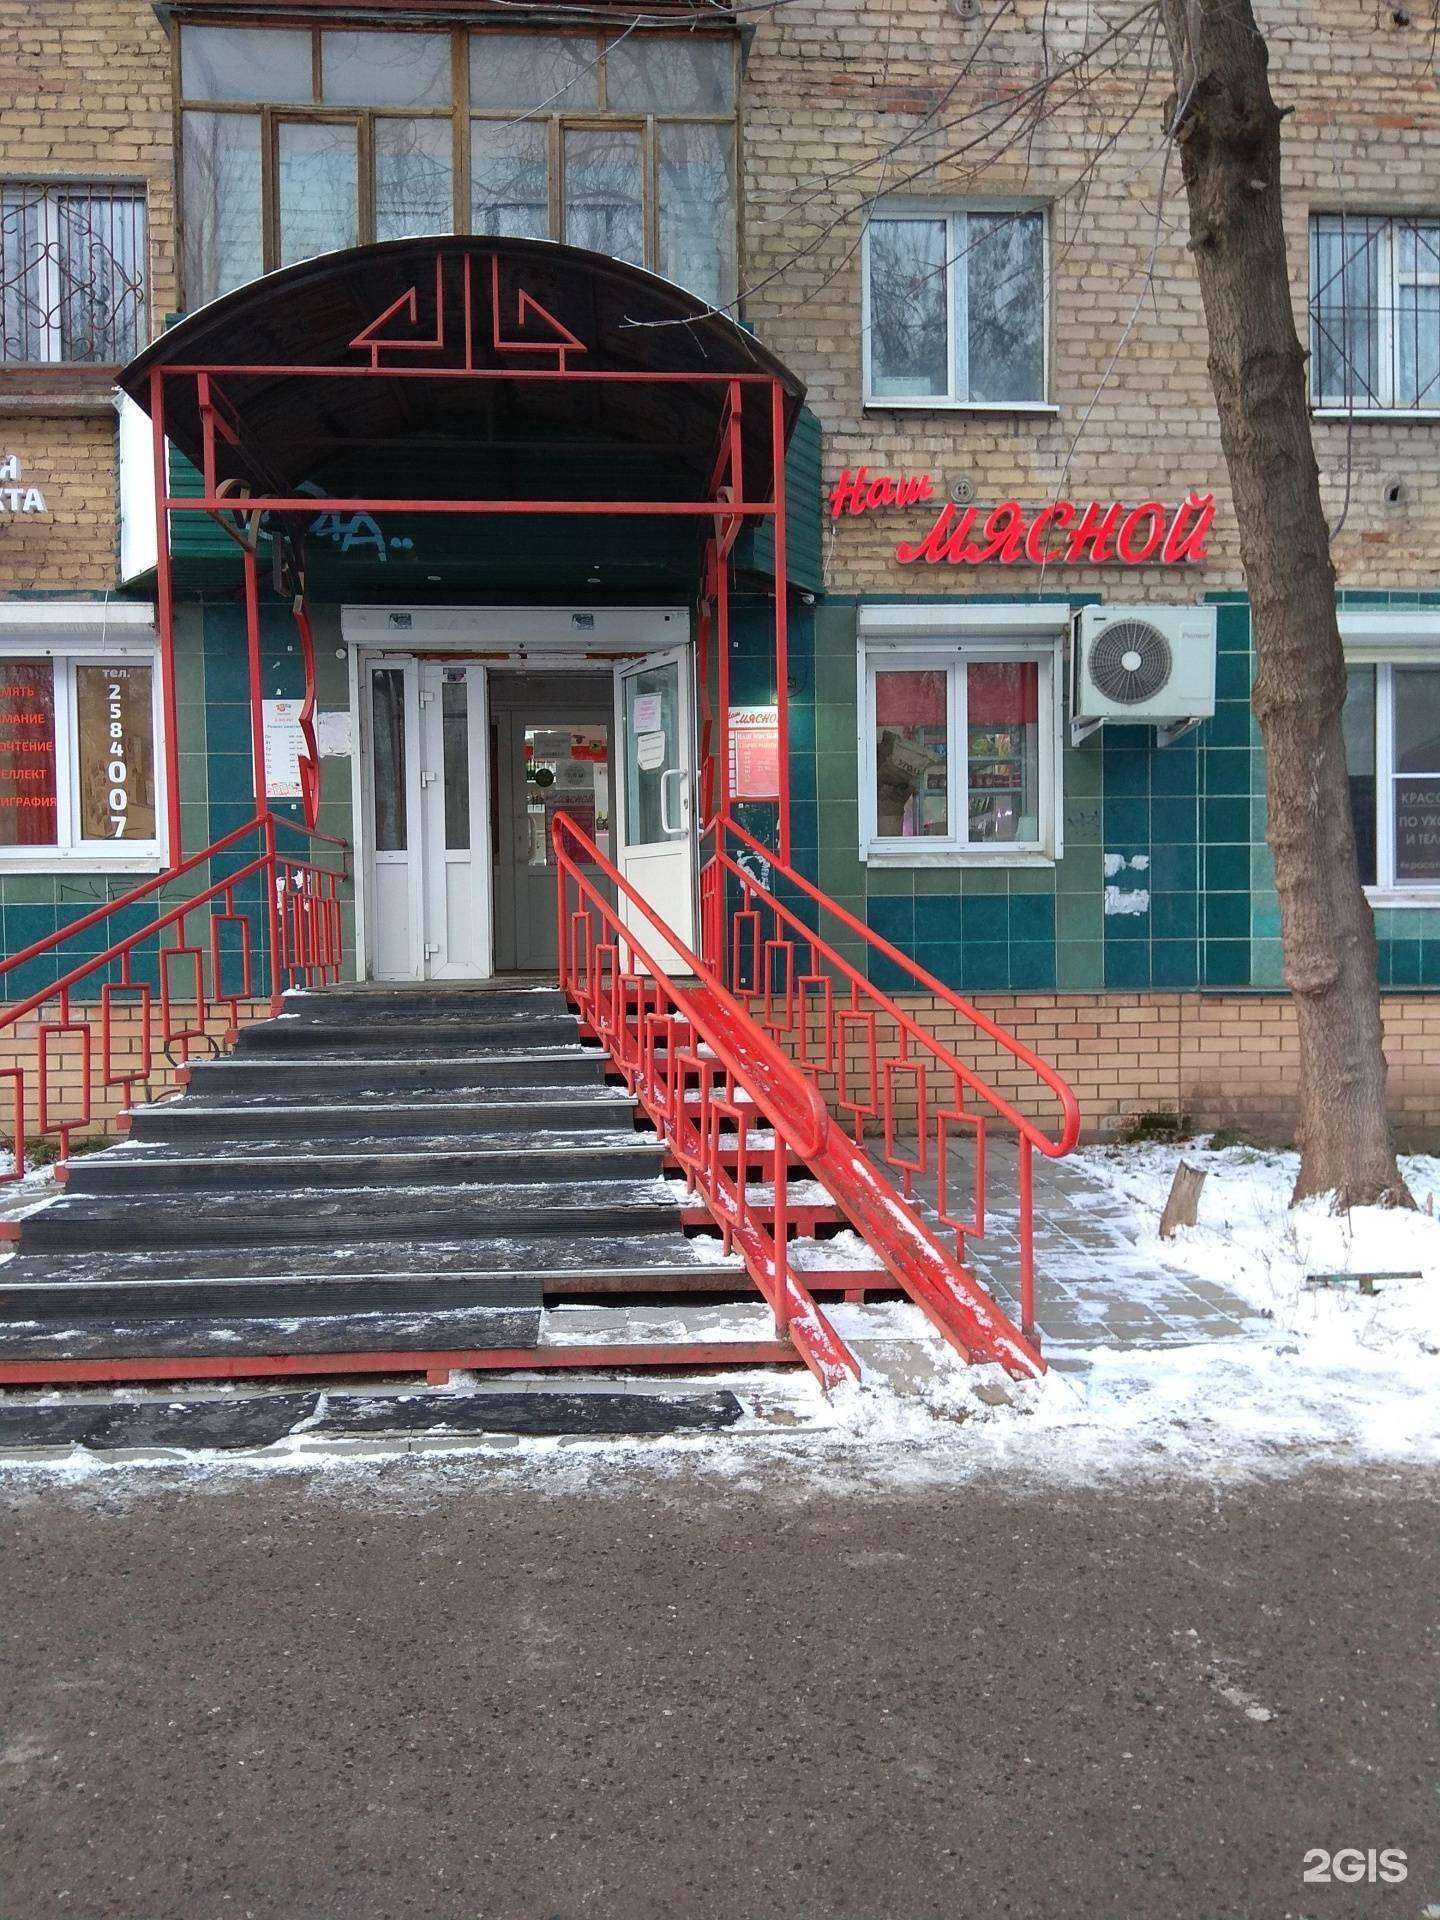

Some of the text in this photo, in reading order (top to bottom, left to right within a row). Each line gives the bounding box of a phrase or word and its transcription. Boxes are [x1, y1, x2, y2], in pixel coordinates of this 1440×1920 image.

[830, 466, 934, 519] Наш
[897, 492, 1215, 564] МЯСНОЙ
[102, 669, 131, 678] тел.
[0, 687, 35, 697] МЯТЬ
[0, 714, 46, 725] МАНИЕ
